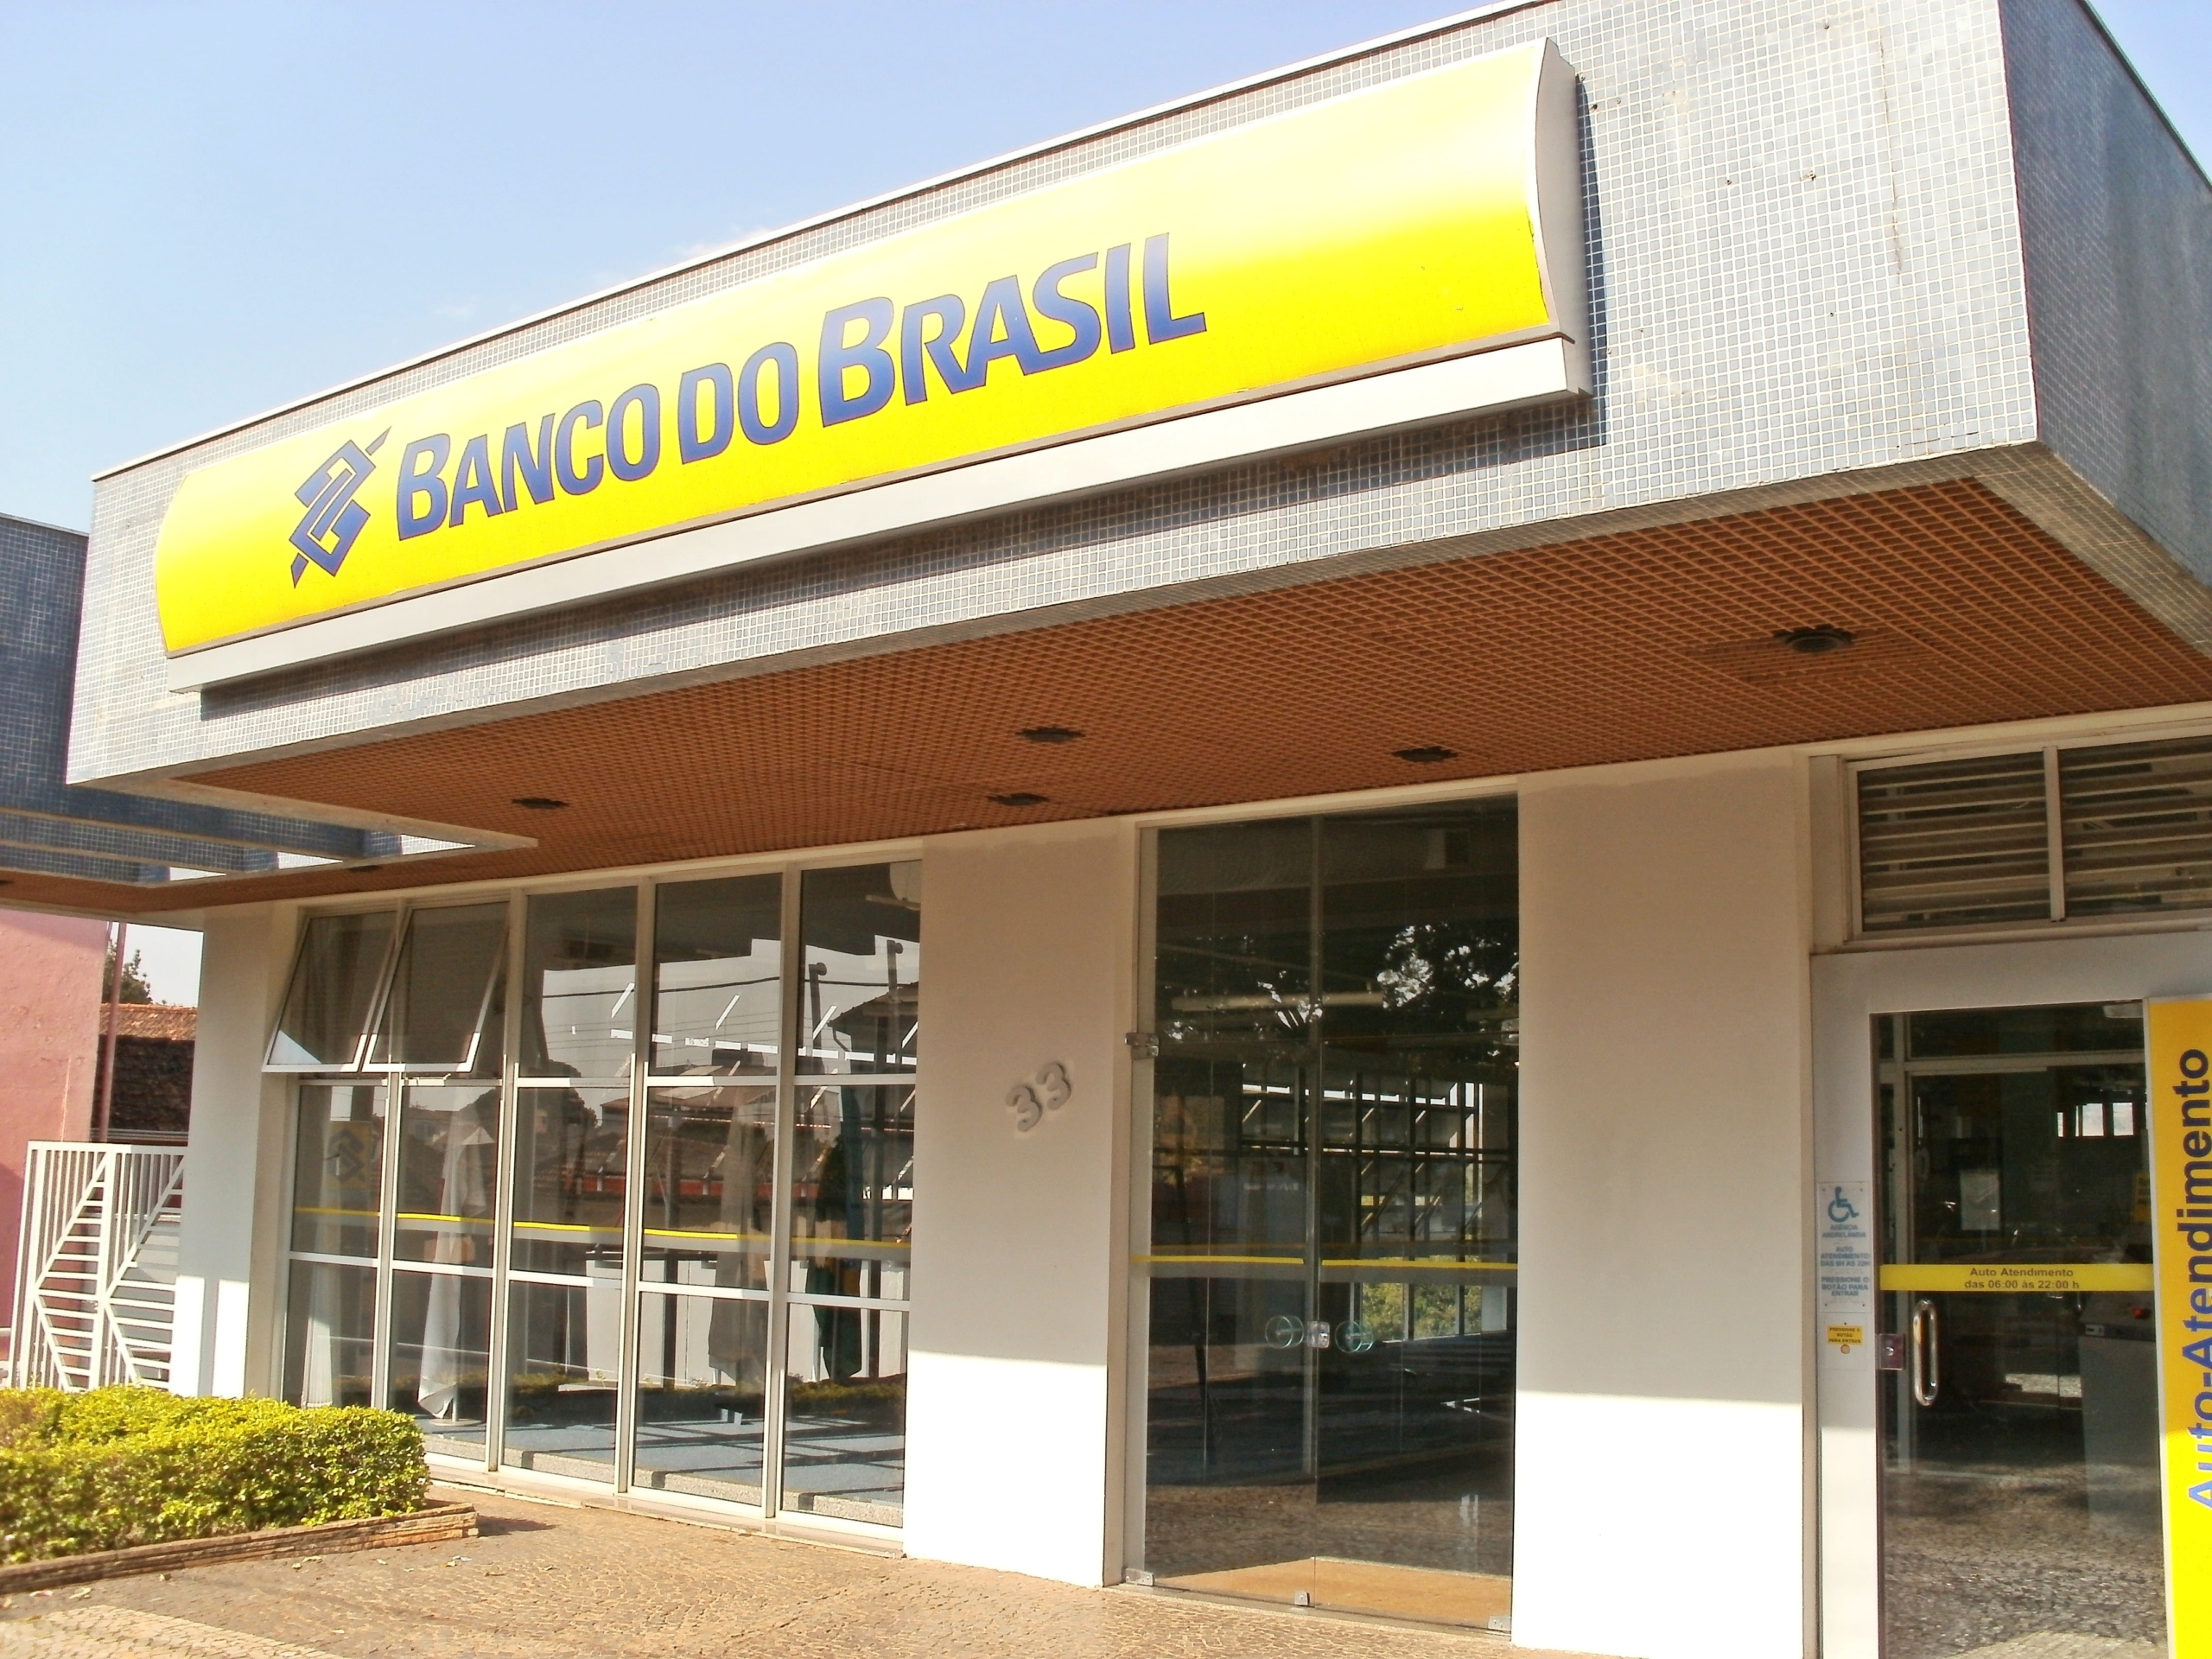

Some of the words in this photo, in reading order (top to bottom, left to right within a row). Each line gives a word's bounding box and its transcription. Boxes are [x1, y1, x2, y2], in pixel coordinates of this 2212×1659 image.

[396, 384, 662, 542] BANCO
[677, 341, 800, 465] DO
[817, 232, 1208, 429] BRASIL
[1006, 1061, 1072, 1133] 33
[1964, 1280, 1985, 1288] das
[1987, 1280, 2018, 1288] 06:00
[2021, 1280, 2035, 1288] às
[2037, 1280, 2069, 1288] 22:00
[1970, 1268, 1997, 1276] Auto
[2000, 1268, 2074, 1277] Atendimento
